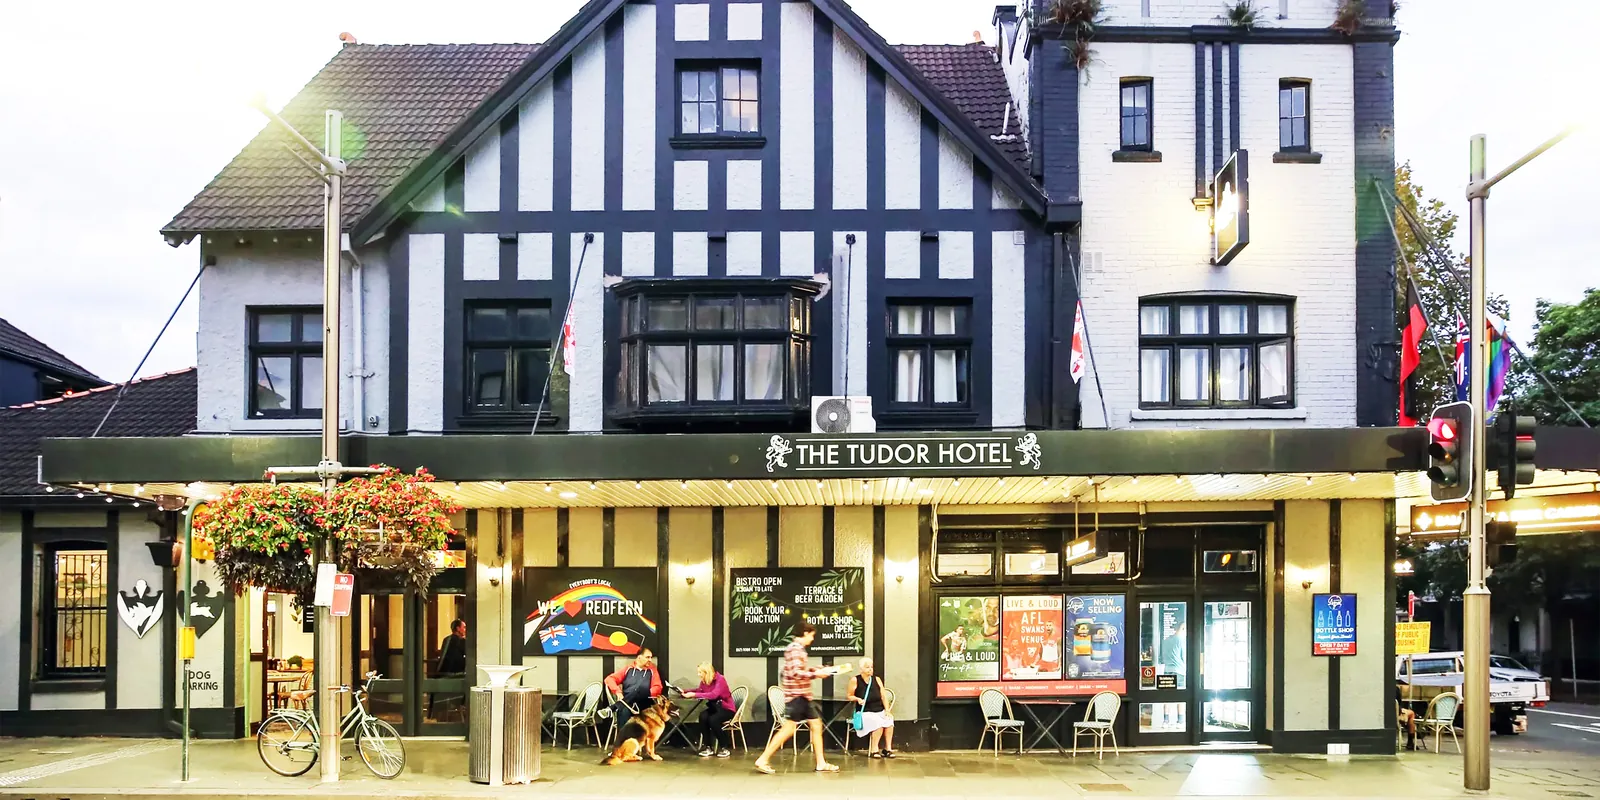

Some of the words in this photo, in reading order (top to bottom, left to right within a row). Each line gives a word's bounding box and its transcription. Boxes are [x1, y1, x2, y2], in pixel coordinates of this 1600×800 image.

[796, 444, 838, 464] THE
[847, 443, 930, 464] TUDOR
[939, 442, 1012, 464] HOTEL
[569, 578, 598, 588] EVERYBODY'S
[598, 580, 612, 588] LOCAL
[736, 577, 762, 585] BISTRO
[764, 576, 782, 585] OPEN
[804, 586, 835, 594] TERRACE
[795, 595, 812, 603] BEER
[815, 594, 843, 603] GARDEN
[538, 600, 558, 615] WE
[586, 600, 642, 615] REDFERN
[745, 606, 763, 614] BOOK
[766, 606, 784, 614] YOUR
[745, 615, 780, 623] FUNCTION
[807, 616, 853, 624] BOTTLESHOP
[1021, 612, 1044, 624] AFL
[966, 652, 972, 661] &
[976, 651, 996, 660] LOUD
[188, 671, 211, 680] DOG
[182, 682, 218, 690] RKING
